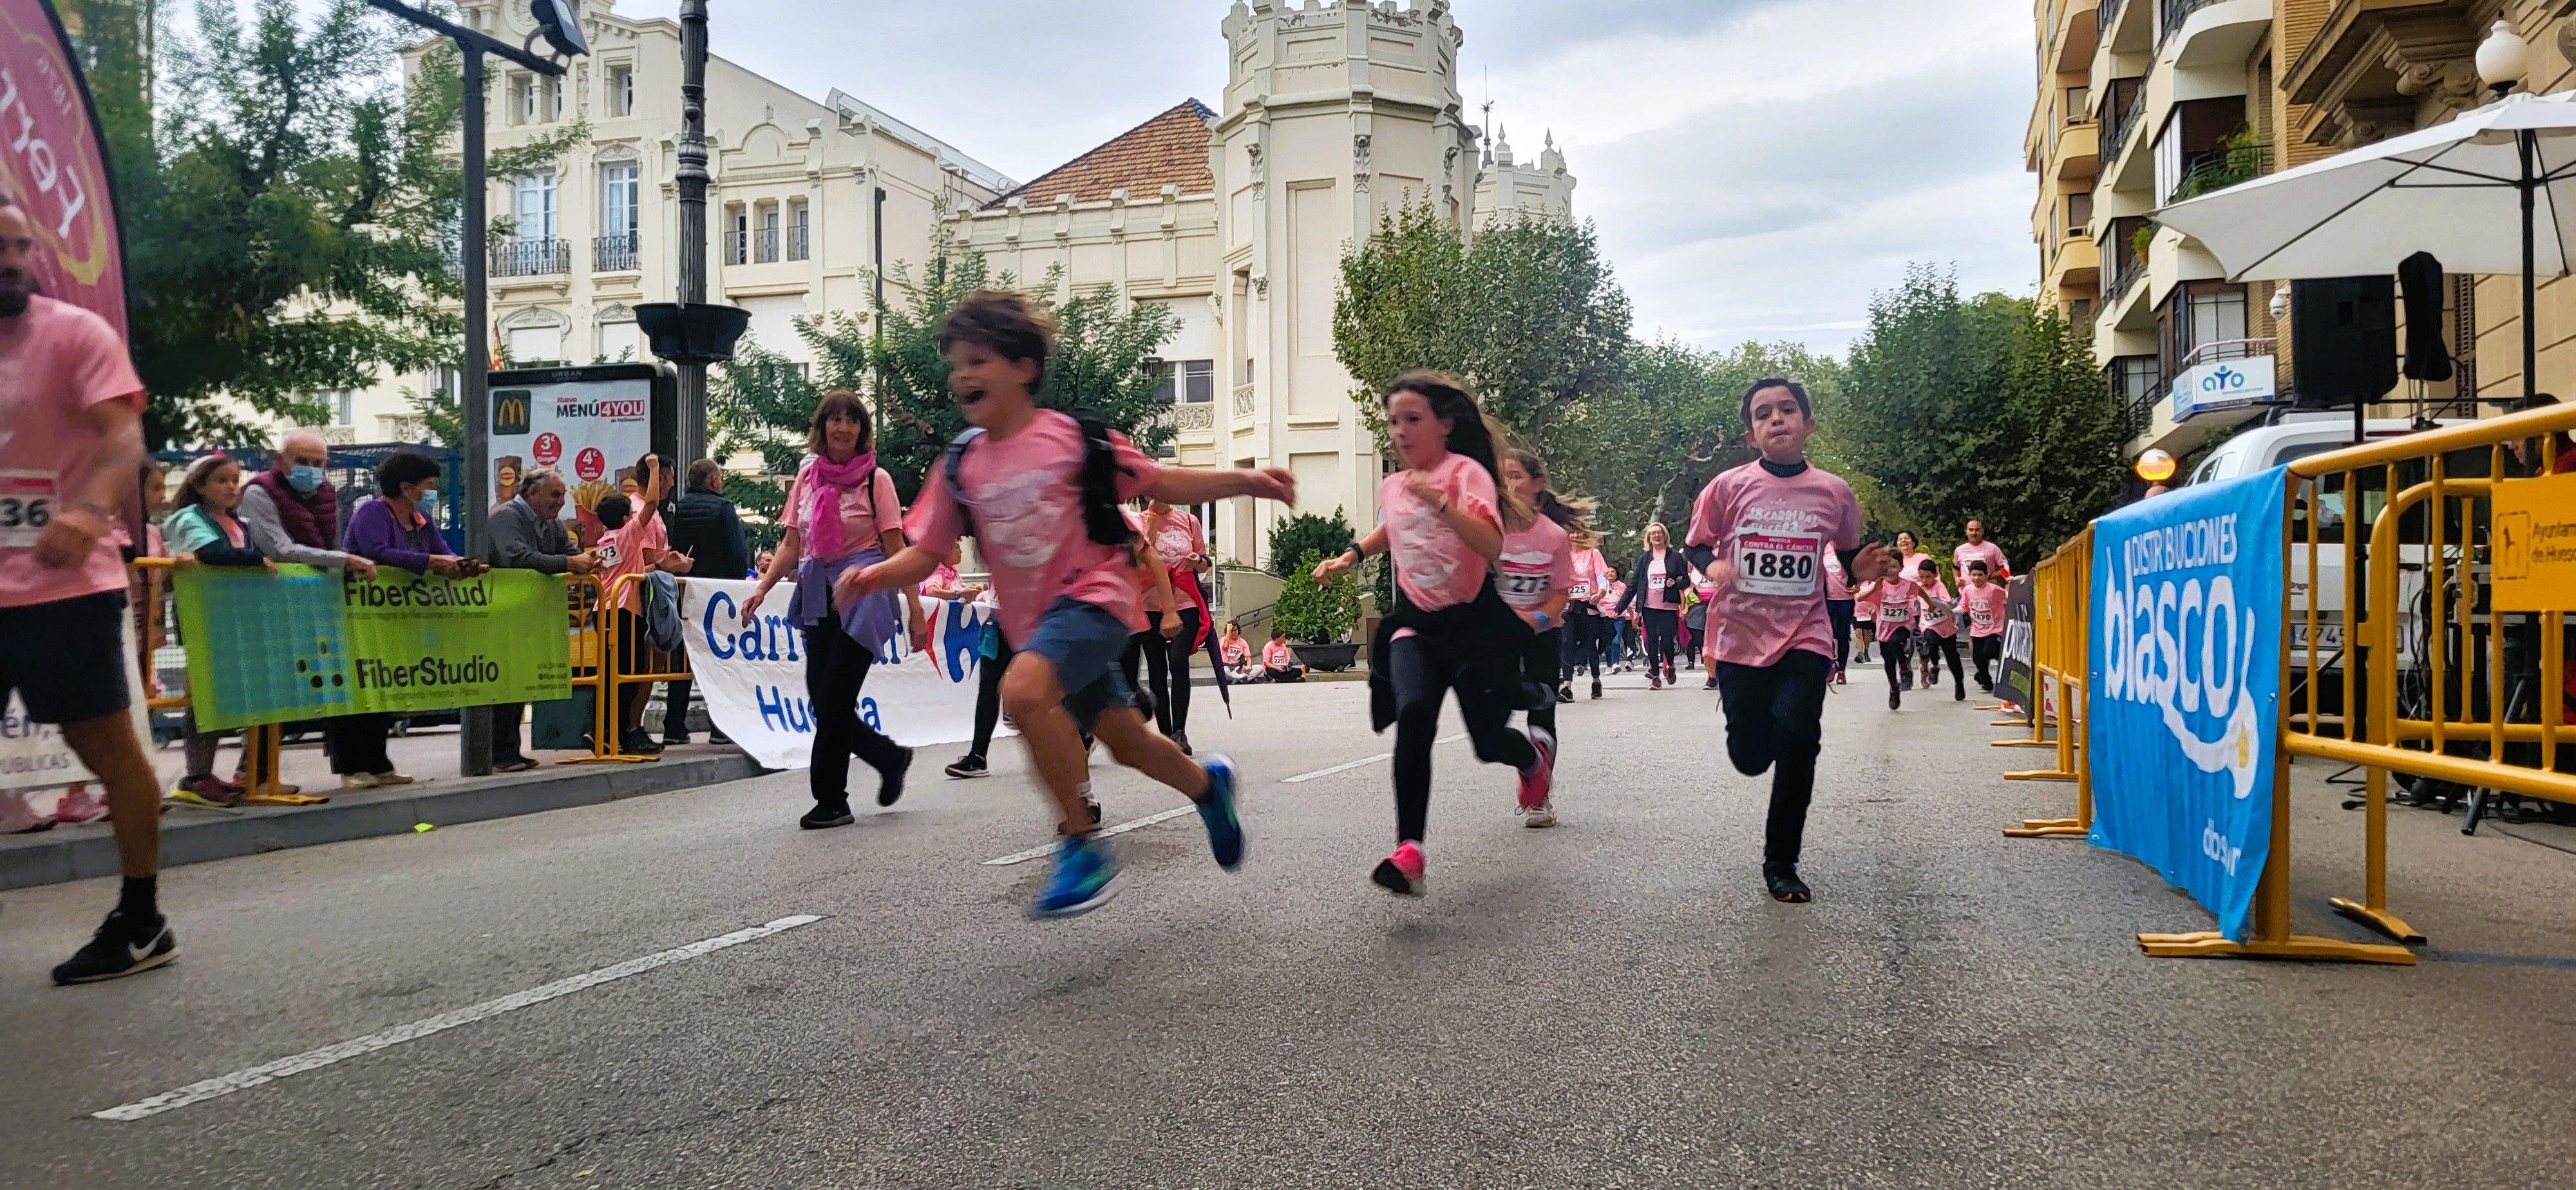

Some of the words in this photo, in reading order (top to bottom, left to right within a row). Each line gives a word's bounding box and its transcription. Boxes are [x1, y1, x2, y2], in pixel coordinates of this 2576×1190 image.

[556, 399, 600, 418] MENÚ
[601, 401, 645, 416] 4YOU
[0, 497, 50, 527] 36
[2132, 513, 2237, 577] DISTRIBUCIONES
[1743, 552, 1812, 579] 1880
[343, 575, 488, 607] FiberSalud
[2104, 545, 2237, 719] blasco
[355, 655, 499, 689] FiberStudio
